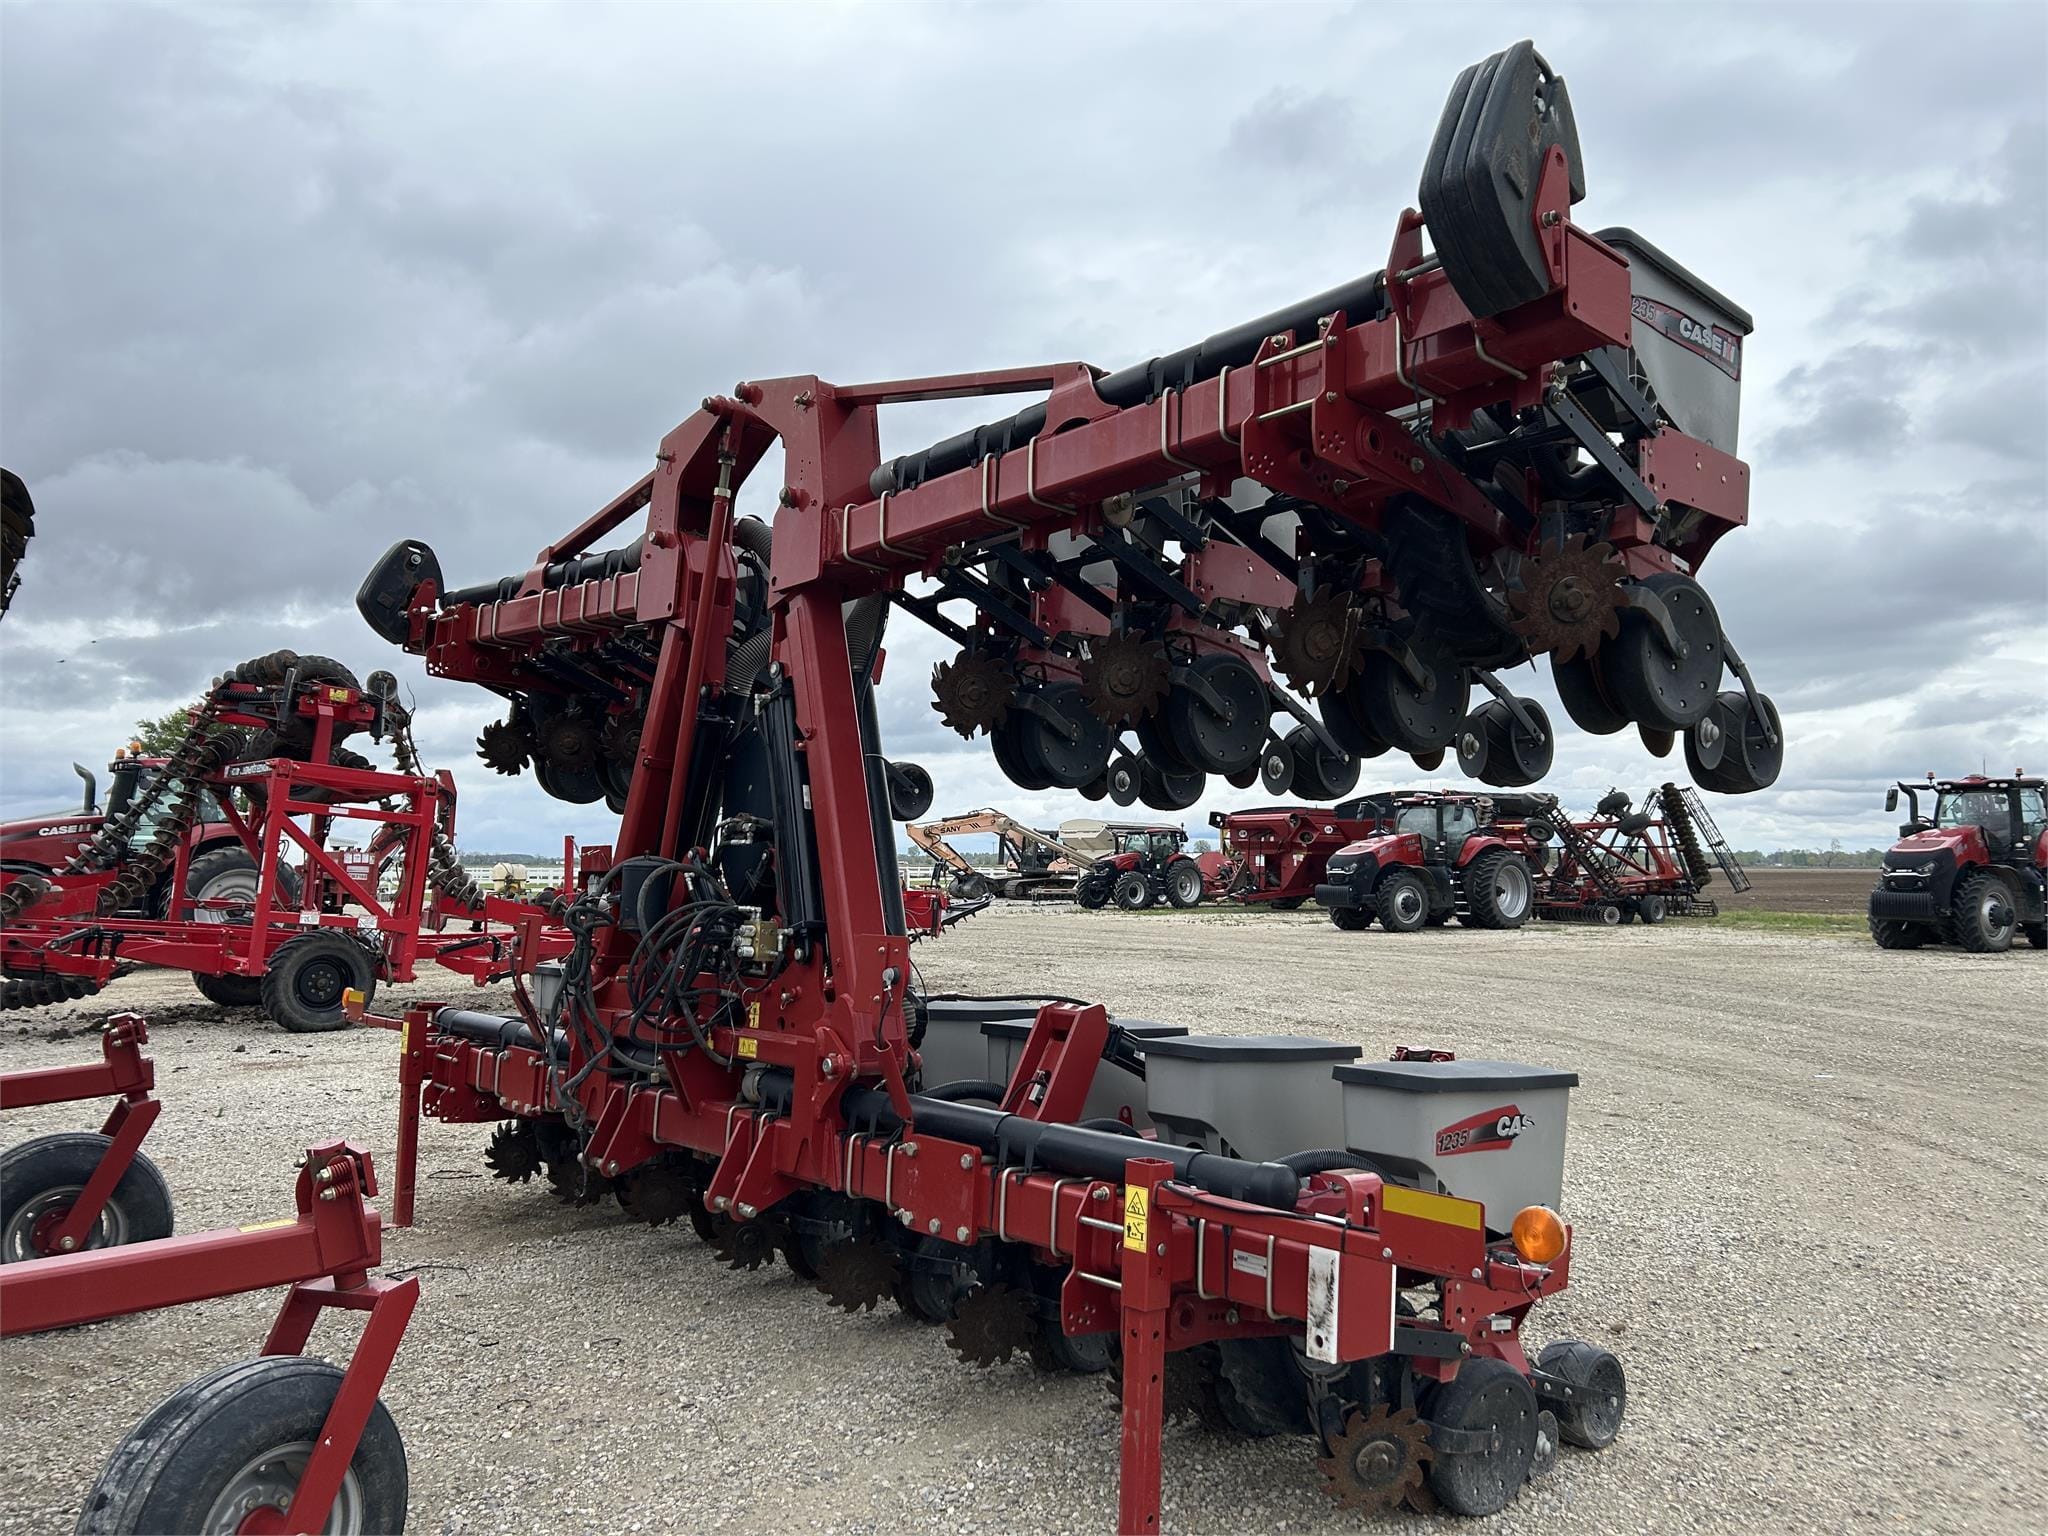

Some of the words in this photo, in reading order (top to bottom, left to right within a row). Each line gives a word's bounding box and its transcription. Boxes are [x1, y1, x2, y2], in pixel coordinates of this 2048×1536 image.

[1631, 298, 1656, 322] 235
[1680, 317, 1722, 355] CASE
[38, 824, 78, 836] CASE
[940, 825, 961, 834] SANY
[1438, 1129, 1469, 1152] 1235
